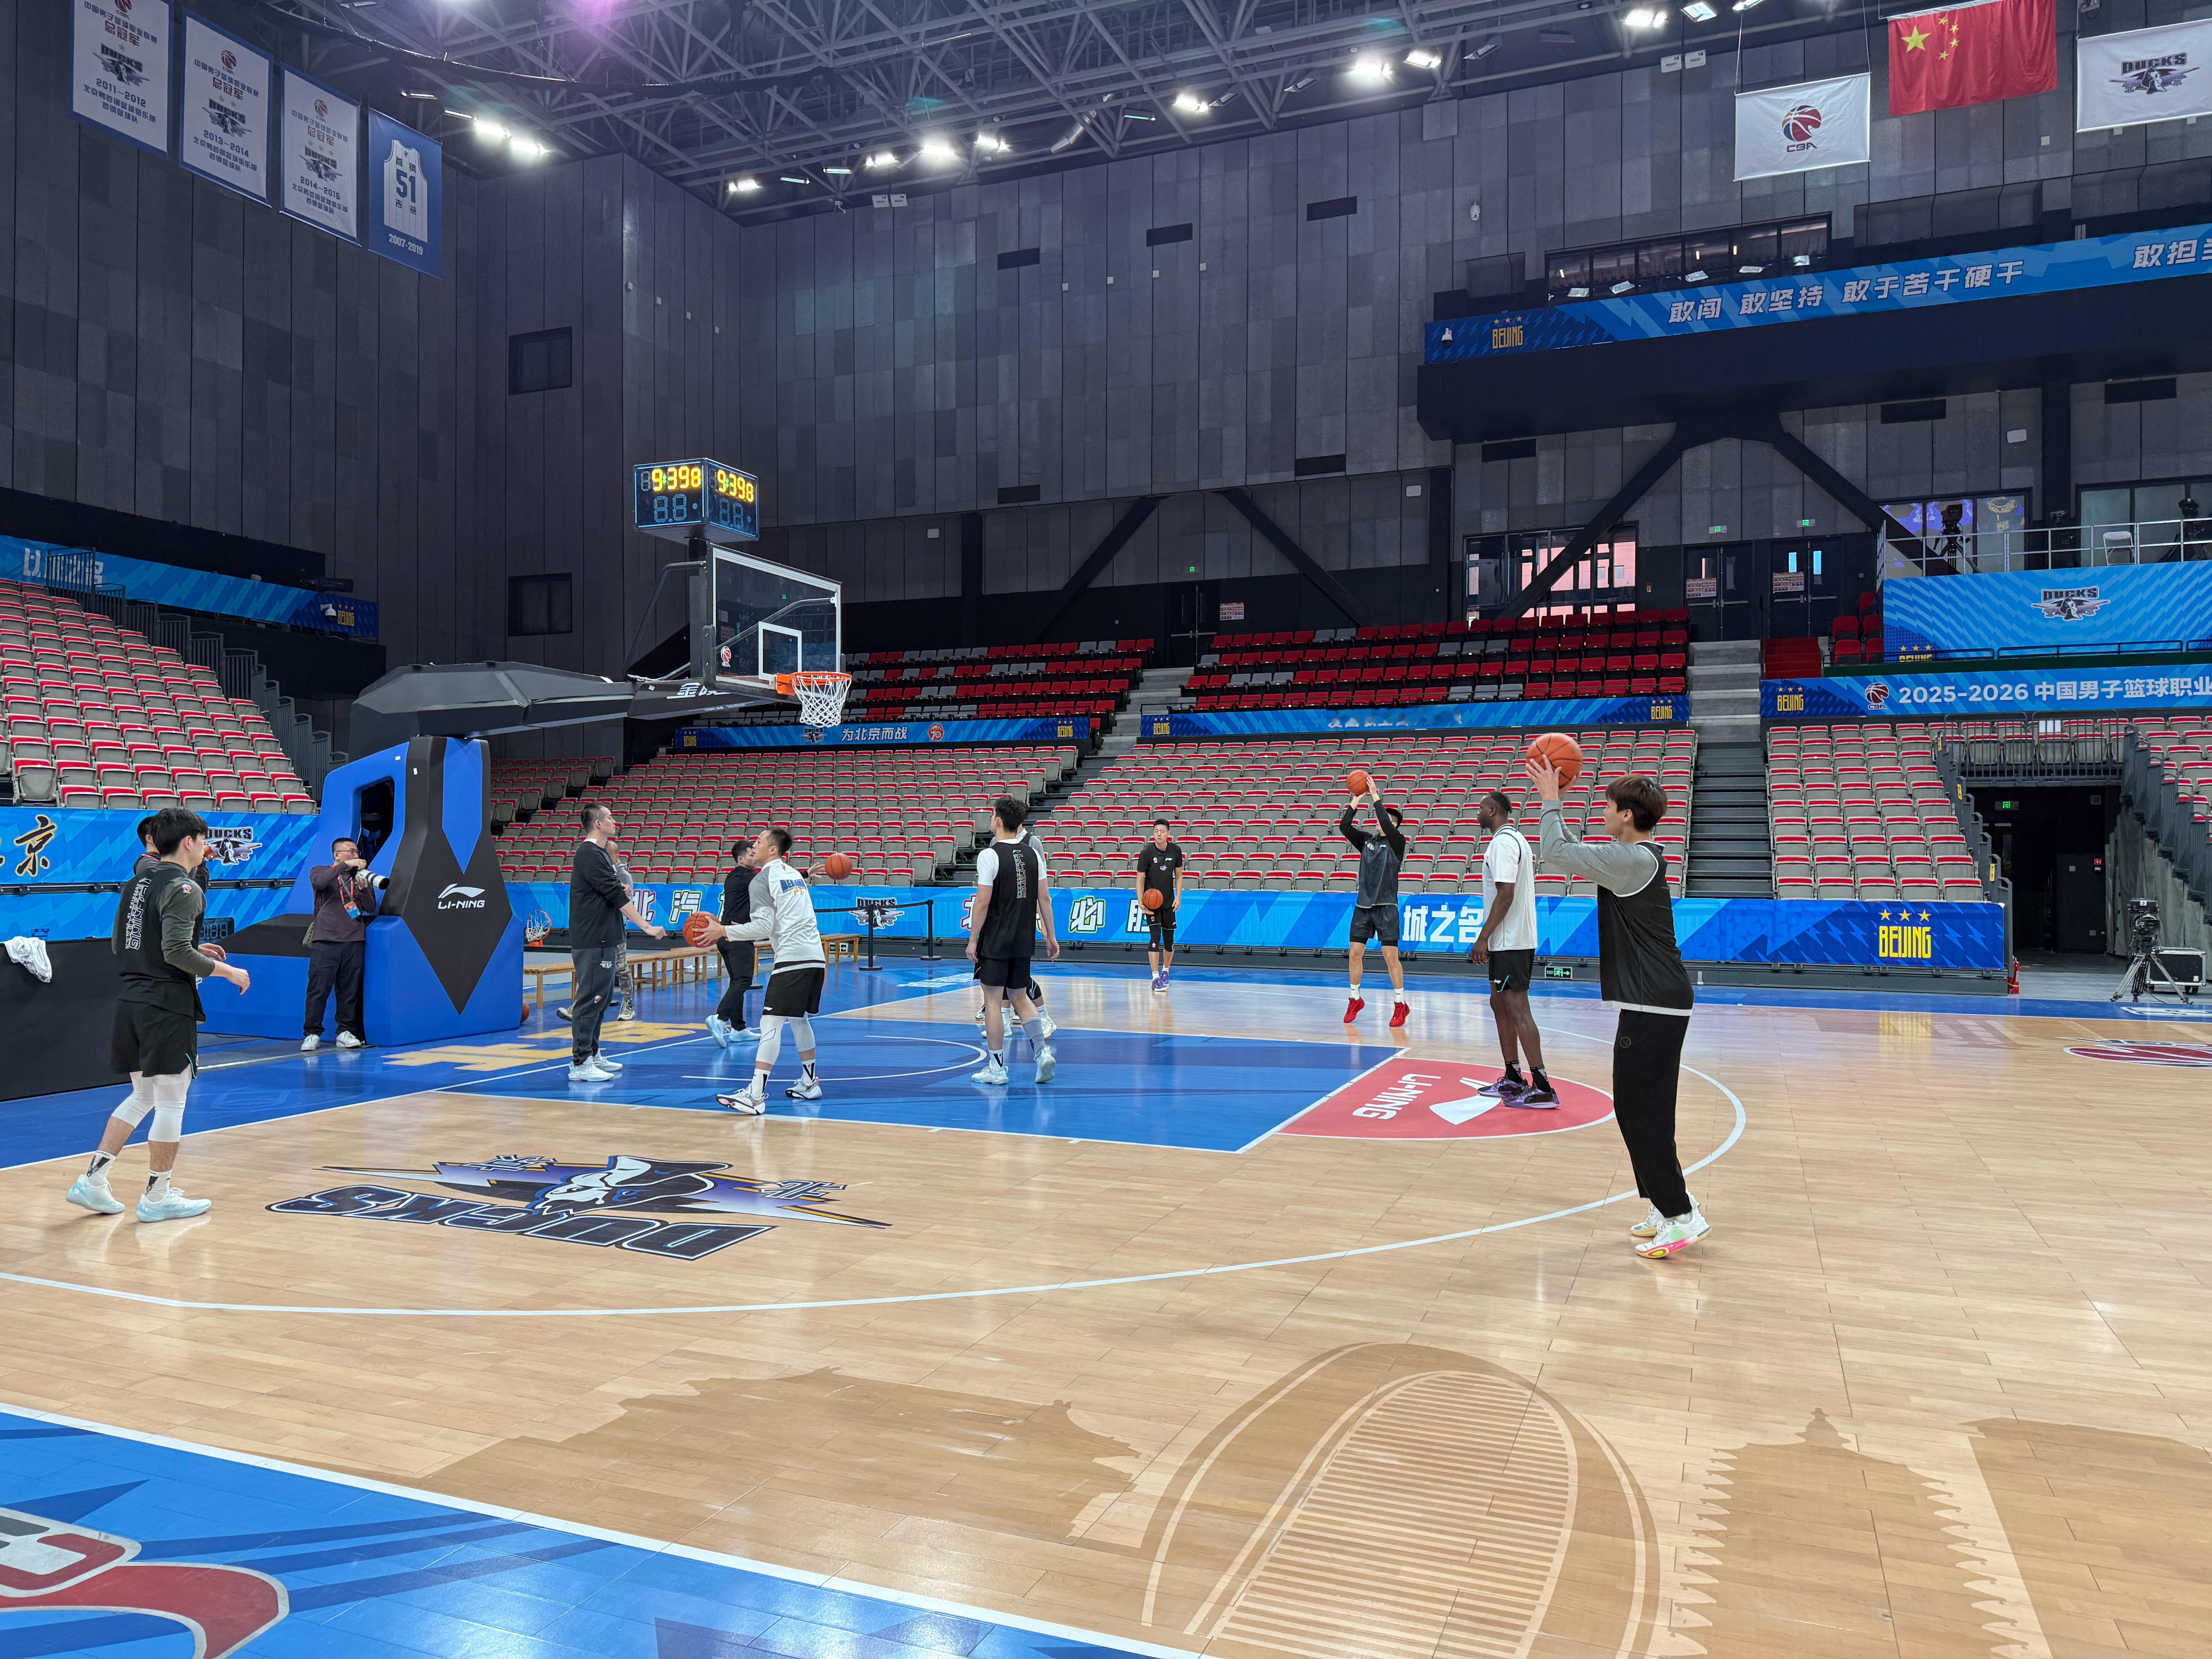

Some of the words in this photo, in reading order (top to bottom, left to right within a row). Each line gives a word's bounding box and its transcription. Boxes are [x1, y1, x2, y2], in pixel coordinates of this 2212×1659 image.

[84, 1, 157, 44] 中国男子篮球职业联赛
[105, 21, 139, 46] 总冠军
[101, 43, 143, 72] DUCKS
[2121, 52, 2187, 75] DUCKS
[195, 58, 259, 97] 中国男子篮球职业联赛
[213, 77, 243, 100] 总冠军
[209, 98, 246, 124] DUCKS
[292, 109, 348, 143] 中国男子篮球职业联赛
[307, 125, 334, 146] 总冠军
[305, 145, 337, 169] DUCKS
[1787, 142, 1817, 153] CBA
[396, 168, 416, 203] 51
[388, 233, 423, 255] 2007-2019
[1668, 297, 1722, 323] 敢闯
[1739, 285, 1824, 315] 敢坚持
[1841, 260, 2024, 304] 敢于苦干硬干
[1492, 325, 1523, 349] BEIJING
[2043, 588, 2098, 601] DUCKS
[1899, 684, 2028, 703] 2025-2026
[2035, 676, 2212, 701] 中国男子篮球职业
[1651, 706, 1672, 720] BEIJING
[1778, 694, 1803, 711] BEIJING
[842, 727, 907, 741] 为北京而战
[1058, 726, 1073, 737] BEIJING
[1154, 723, 1170, 735] BEIJING
[438, 900, 485, 909] LI-NING
[1879, 926, 1931, 958] BEIJING
[1352, 1073, 1441, 1120] LI-NING
[271, 1184, 778, 1261] DUCKS
